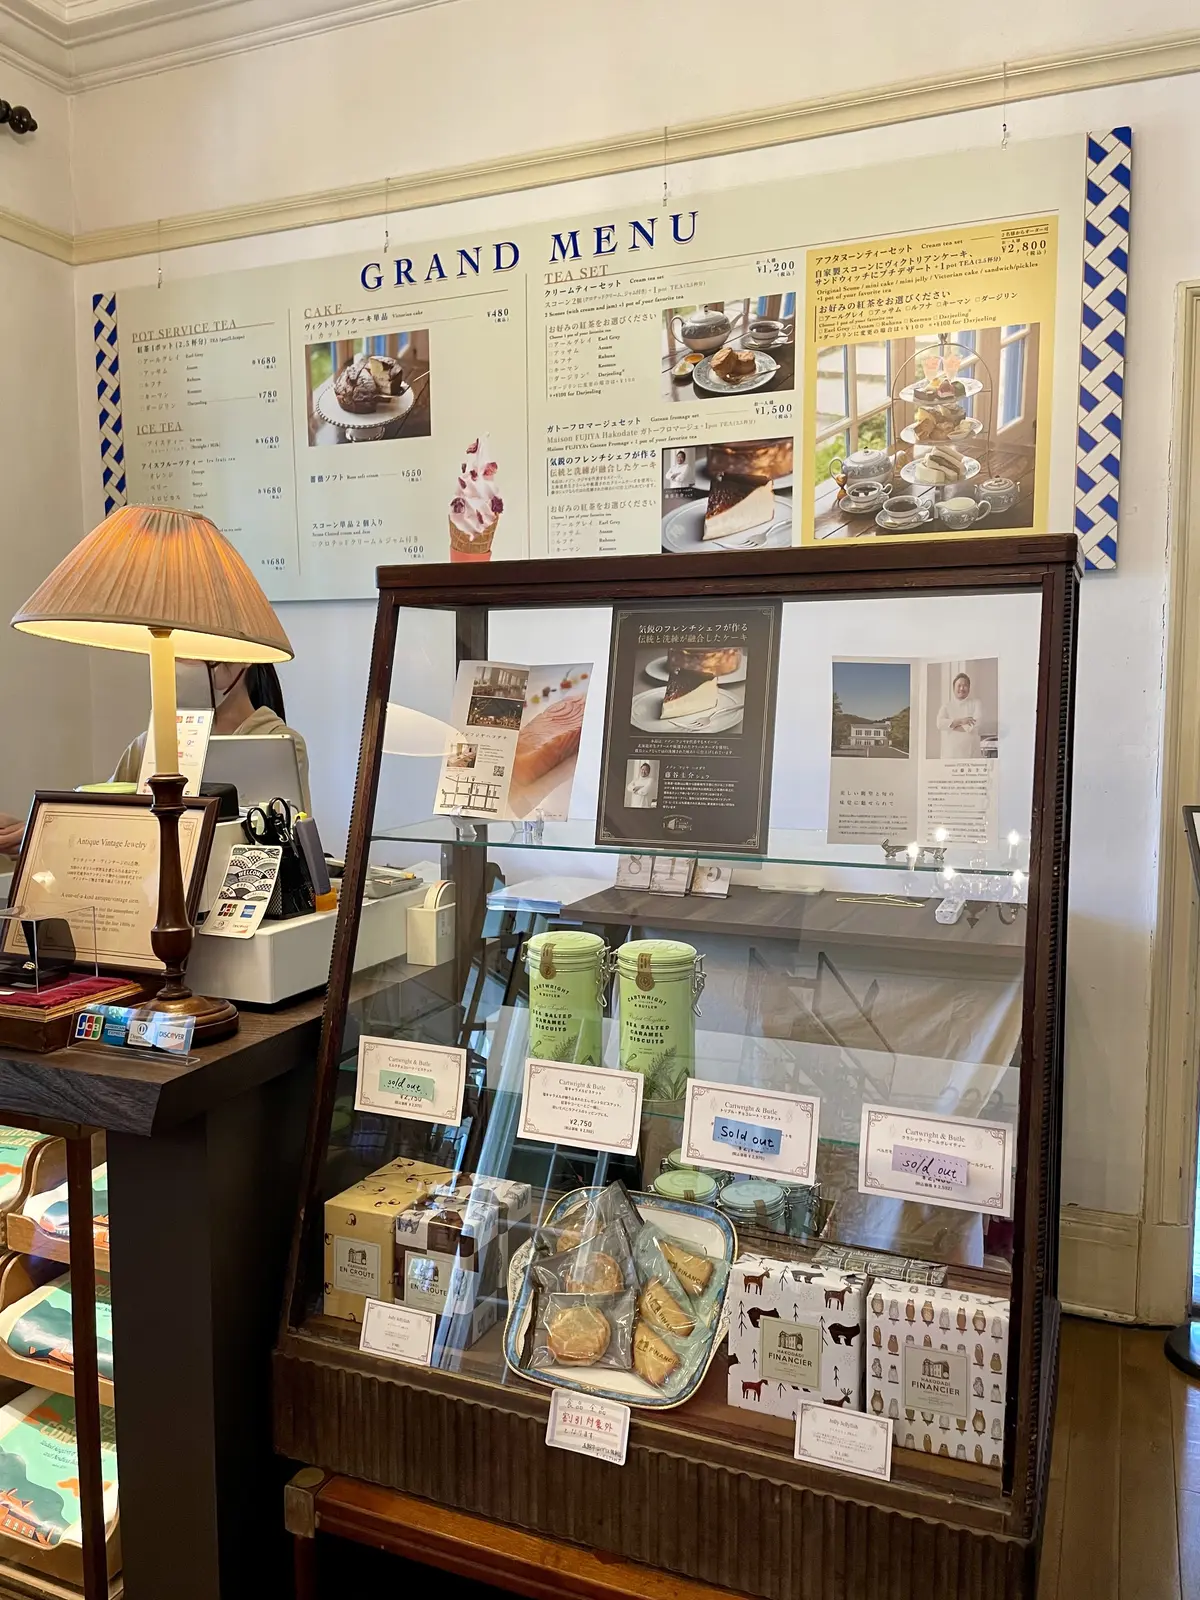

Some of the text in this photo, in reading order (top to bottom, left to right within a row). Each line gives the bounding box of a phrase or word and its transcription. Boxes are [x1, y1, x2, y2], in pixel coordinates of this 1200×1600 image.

[361, 211, 698, 290] GRAND MENU
[1001, 240, 1046, 253] ¥2,800
[815, 244, 913, 265] アフタヌーンティーセット
[757, 260, 795, 274] ¥1,200
[815, 250, 973, 279] 自家製スコーンにヴィクトリアンケーキ、
[544, 264, 608, 285] TEA SET
[815, 264, 930, 286] サンドウィッチにプチデザート
[816, 287, 842, 295] Original
[843, 284, 860, 292] Scone
[914, 276, 928, 284] jelly
[934, 271, 963, 280] Victorian
[984, 261, 1038, 274] sandwich/pickles
[545, 279, 622, 298] クリームティーセット
[819, 290, 951, 314] お好みの紅茶をお選びください
[824, 310, 864, 321] アールグレイ
[874, 306, 902, 315] アッサム
[942, 298, 971, 307] キーマン
[982, 292, 1018, 302] ダージリン
[304, 304, 343, 319] CAKE
[487, 308, 510, 318] ¥480
[304, 312, 389, 331] ヴィクトリアンケーキ単品
[549, 313, 657, 334] お好みの紅茶をお選びください
[963, 315, 997, 324] Darjeeling
[132, 319, 237, 343] POT SERVICE TEA
[257, 356, 277, 366] ¥680
[258, 390, 278, 399] ¥780
[755, 404, 792, 415] ¥1,500
[136, 421, 182, 436] ICE TEA
[547, 417, 641, 433] ガトーフロマージュセット
[261, 436, 280, 445] ¥680
[547, 436, 573, 444] Maison
[575, 433, 600, 442] FUJIYA
[602, 429, 638, 439] Hakodate
[550, 450, 657, 466] 気鋭のフレンチシェフが作る
[141, 459, 203, 470] アイスフルーツティー
[550, 462, 657, 478] 伝統と洗練が融合したケーキ
[402, 468, 422, 478] ¥550
[263, 486, 282, 495] ¥680
[550, 500, 657, 513] お好みの紅茶をお選びください
[312, 519, 384, 530] スコーン単品2個入り
[404, 546, 424, 554] ¥600
[267, 558, 285, 566] ¥680
[639, 623, 748, 634] 気鋭のフレンチシェフが作る
[638, 633, 748, 644] 伝統と洗練が融合したケーキ
[76, 838, 147, 850] Antique Vintage Jewelry
[238, 869, 264, 878] WELCOME
[534, 983, 570, 994] CARTWRIGHT
[627, 995, 667, 1006] CARTWRIGHT
[78, 1021, 100, 1032] JCB
[536, 1017, 566, 1025] CARAMEL
[536, 1023, 567, 1032] BISCUITS
[630, 1029, 663, 1037] CARAMEL
[158, 1031, 185, 1040] DISCOVER
[630, 1036, 664, 1044] BISCUITS
[388, 1077, 421, 1092] sold out
[559, 1078, 586, 1088] Cartwright
[724, 1102, 755, 1112] Cartwright
[570, 1118, 592, 1128] ¥2,750
[720, 1126, 774, 1148] Sold out
[905, 1128, 939, 1139] Cartwright
[948, 1134, 965, 1143] Butle
[902, 1158, 957, 1179] sold out
[350, 1268, 375, 1279] CROUTE
[421, 1286, 447, 1296] CROUTE
[768, 1352, 812, 1367] FINANCIER
[912, 1380, 960, 1396] FINANCIER
